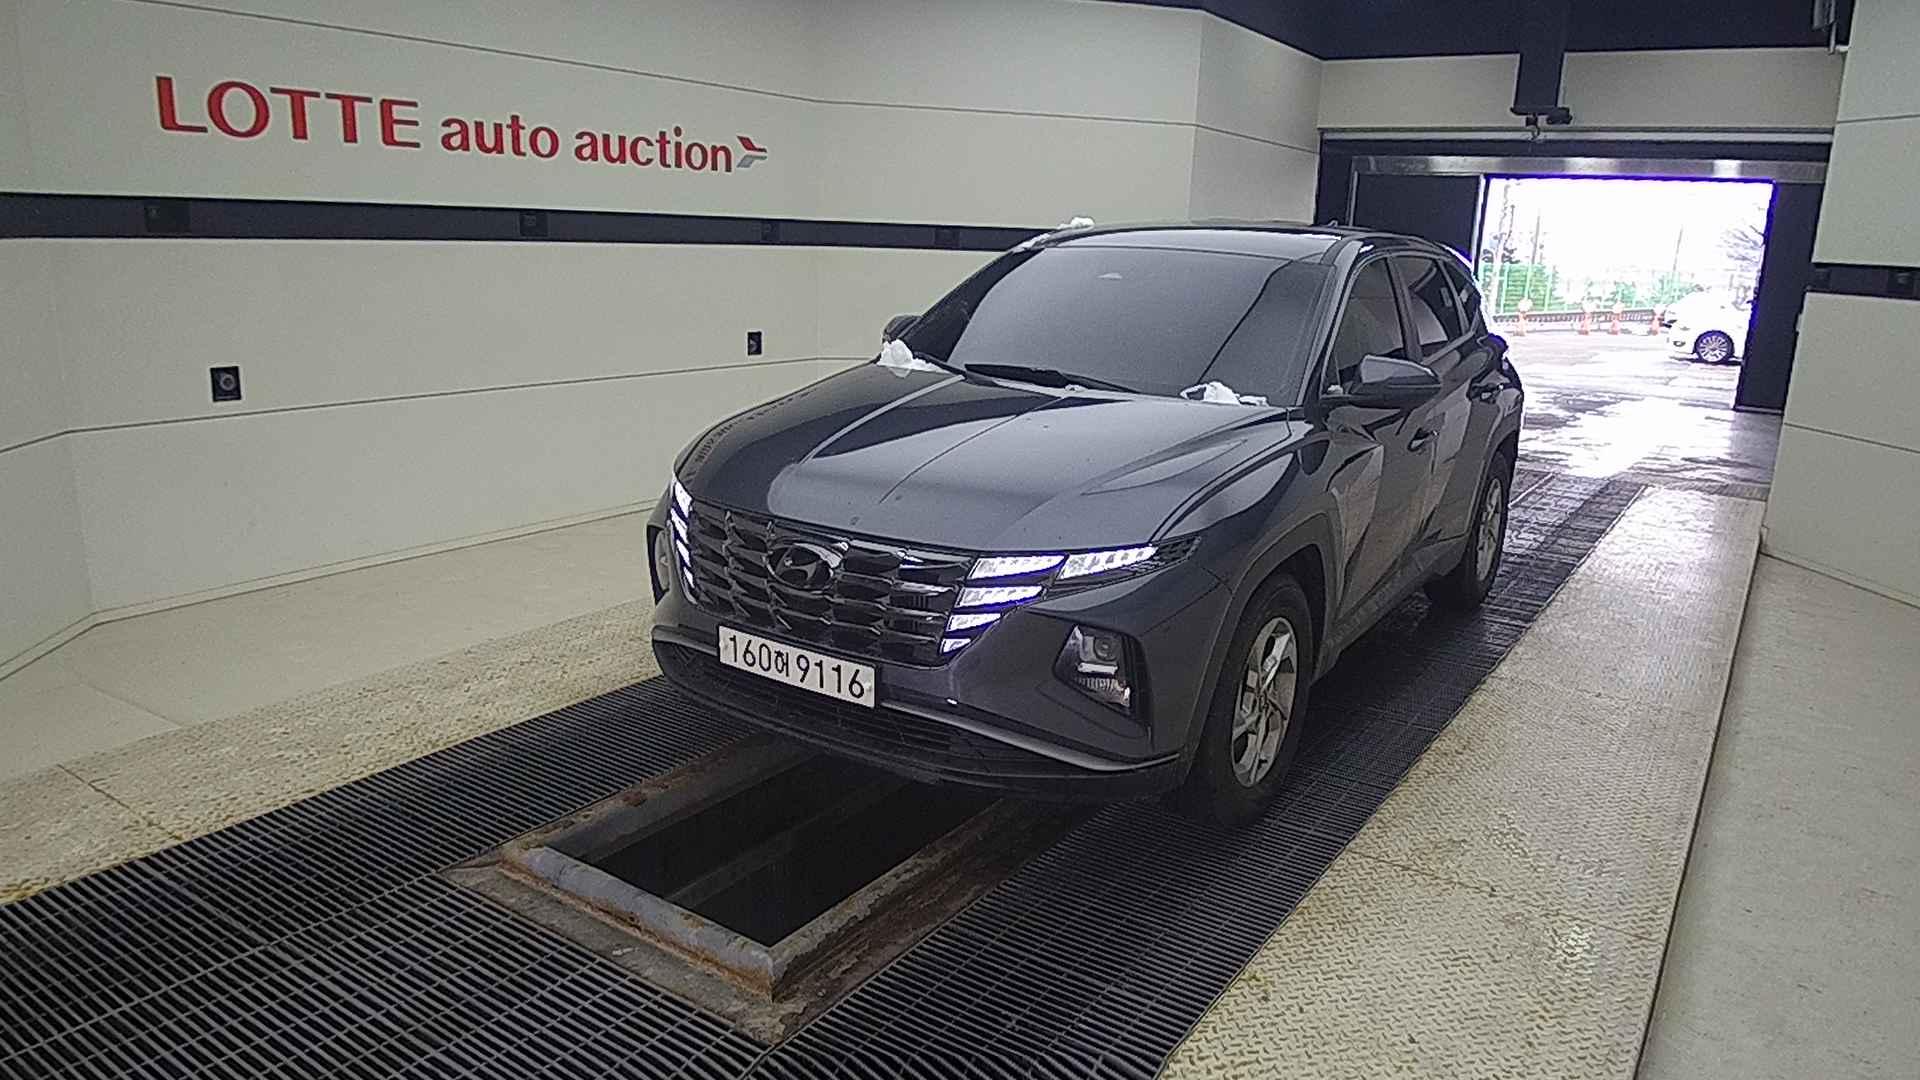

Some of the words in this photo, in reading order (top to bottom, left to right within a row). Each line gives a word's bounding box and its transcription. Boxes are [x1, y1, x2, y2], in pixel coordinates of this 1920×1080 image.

[156, 75, 421, 149] LOTTE
[440, 114, 560, 159] auto
[574, 125, 733, 173] auction
